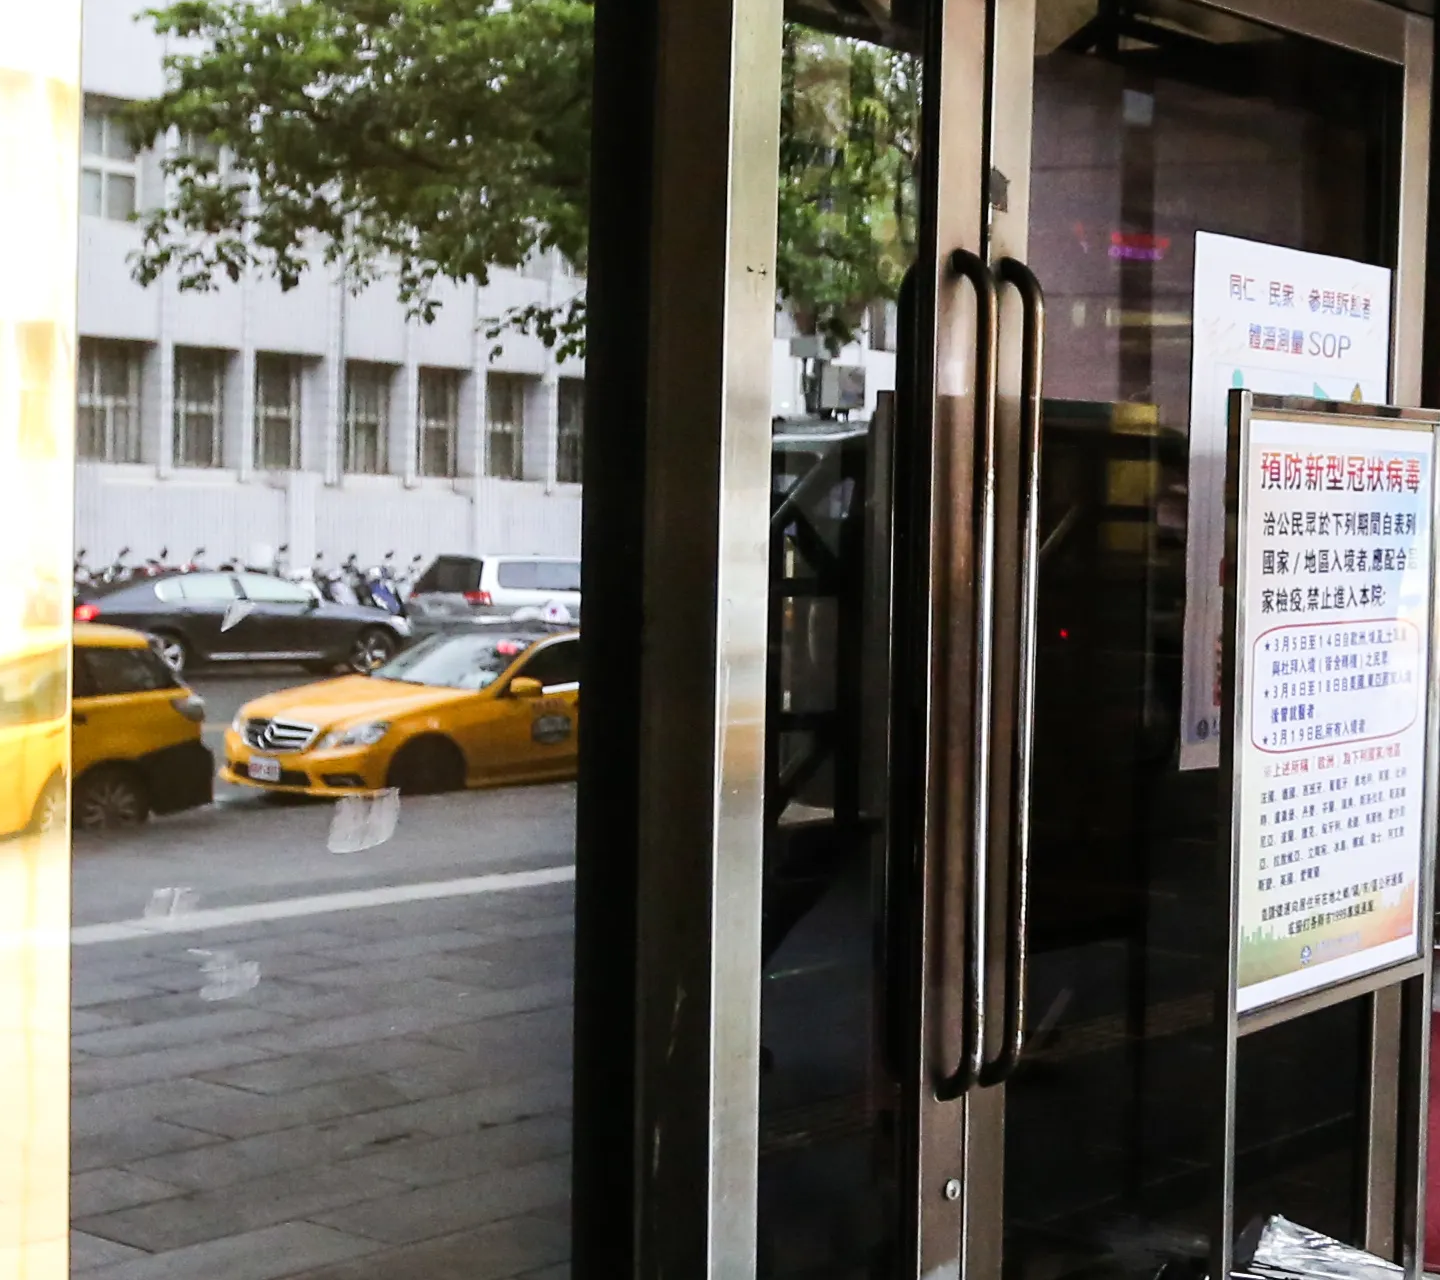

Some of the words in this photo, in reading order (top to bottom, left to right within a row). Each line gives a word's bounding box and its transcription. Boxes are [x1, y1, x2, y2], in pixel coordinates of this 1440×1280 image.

[1308, 330, 1352, 359] SOP
[1260, 451, 1421, 494] 預防新型冠狀病毒
